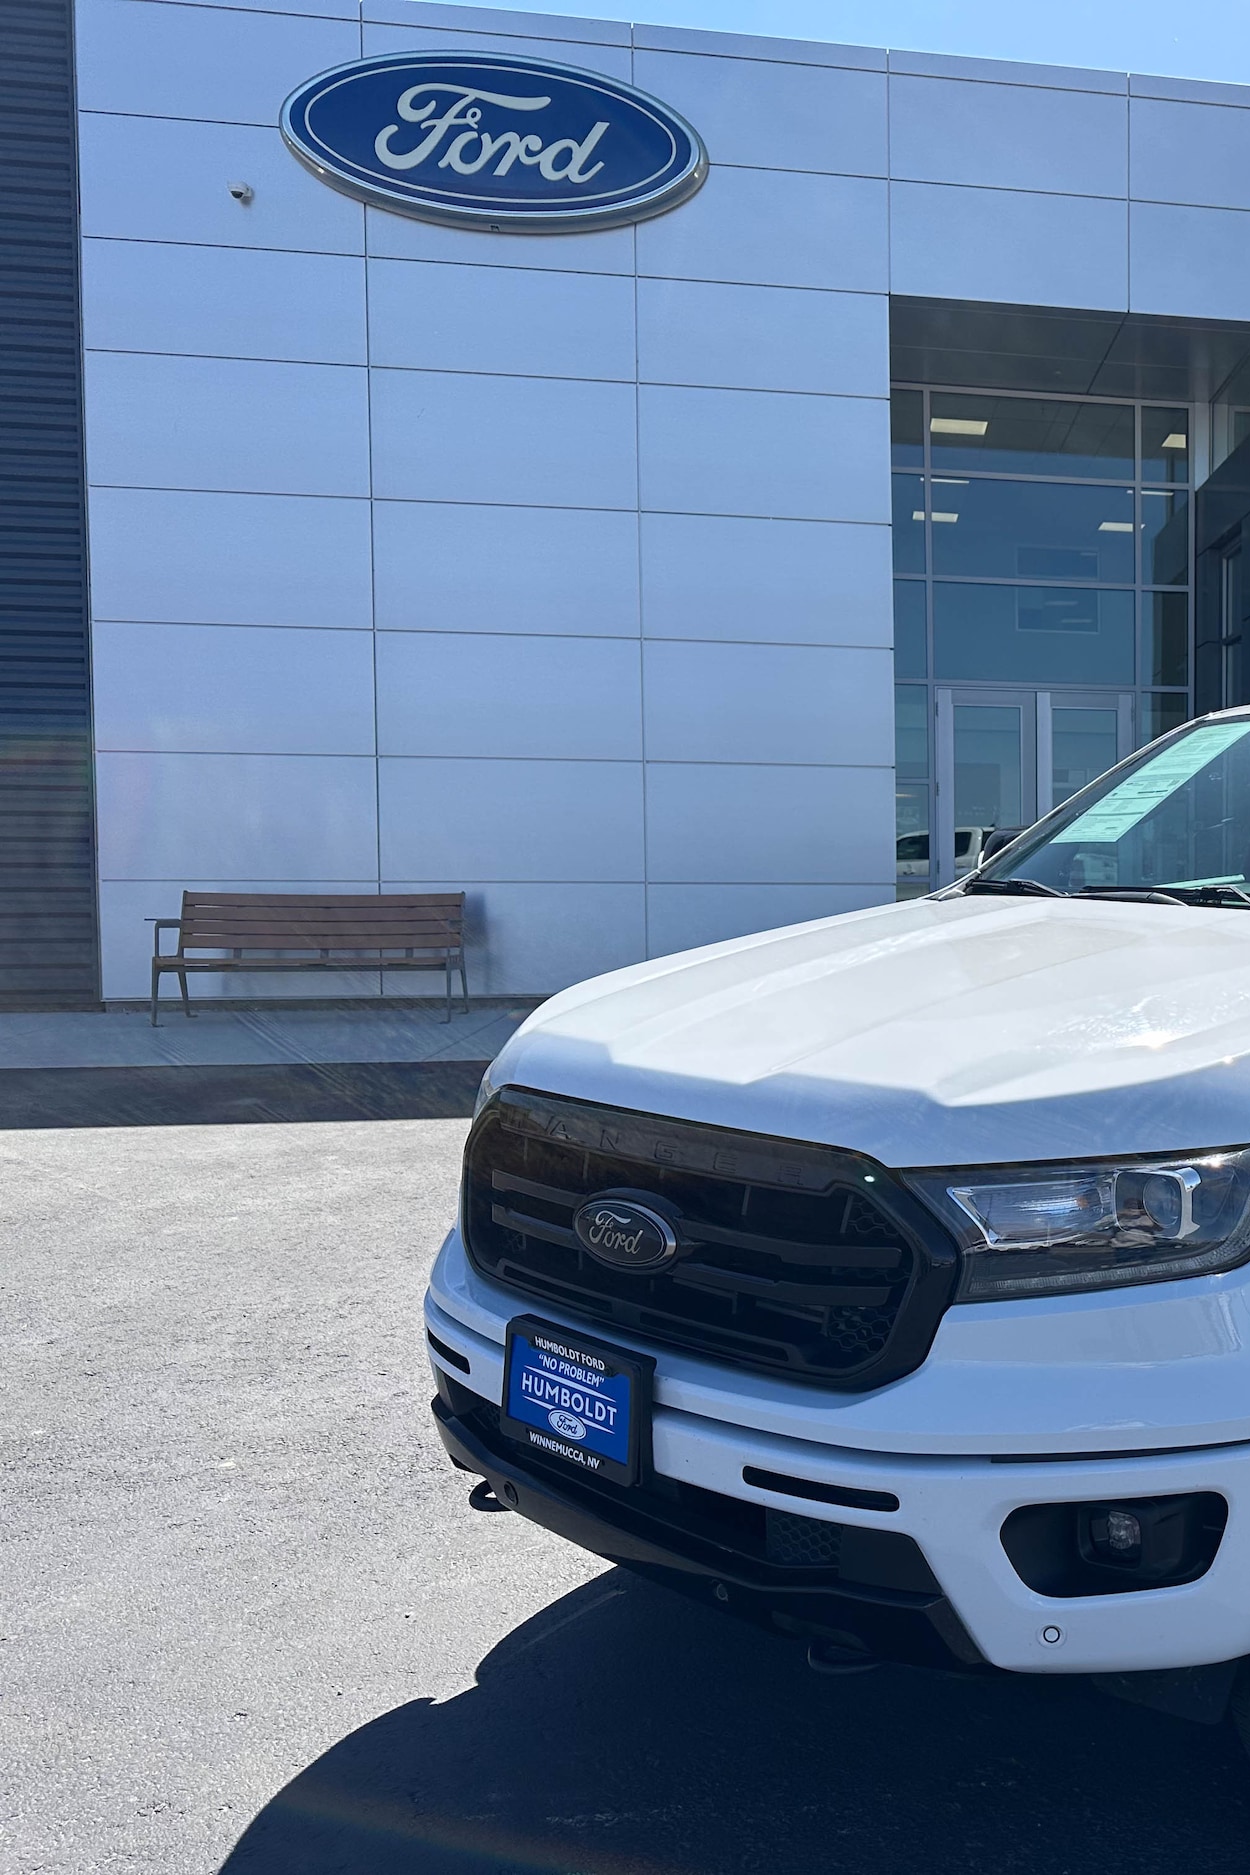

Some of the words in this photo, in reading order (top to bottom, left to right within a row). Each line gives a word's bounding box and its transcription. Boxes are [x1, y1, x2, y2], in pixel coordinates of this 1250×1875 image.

[374, 82, 610, 184] Ford
[508, 1106, 806, 1187] ANGER
[588, 1210, 644, 1255] Ford
[534, 1335, 581, 1363] HUMBOLDT
[581, 1351, 606, 1372] FORD
[521, 1372, 618, 1426] HUMBOLDT
[556, 1413, 580, 1436] Ford
[529, 1431, 587, 1466] WINNEMUCCA,
[587, 1456, 601, 1470] NV
